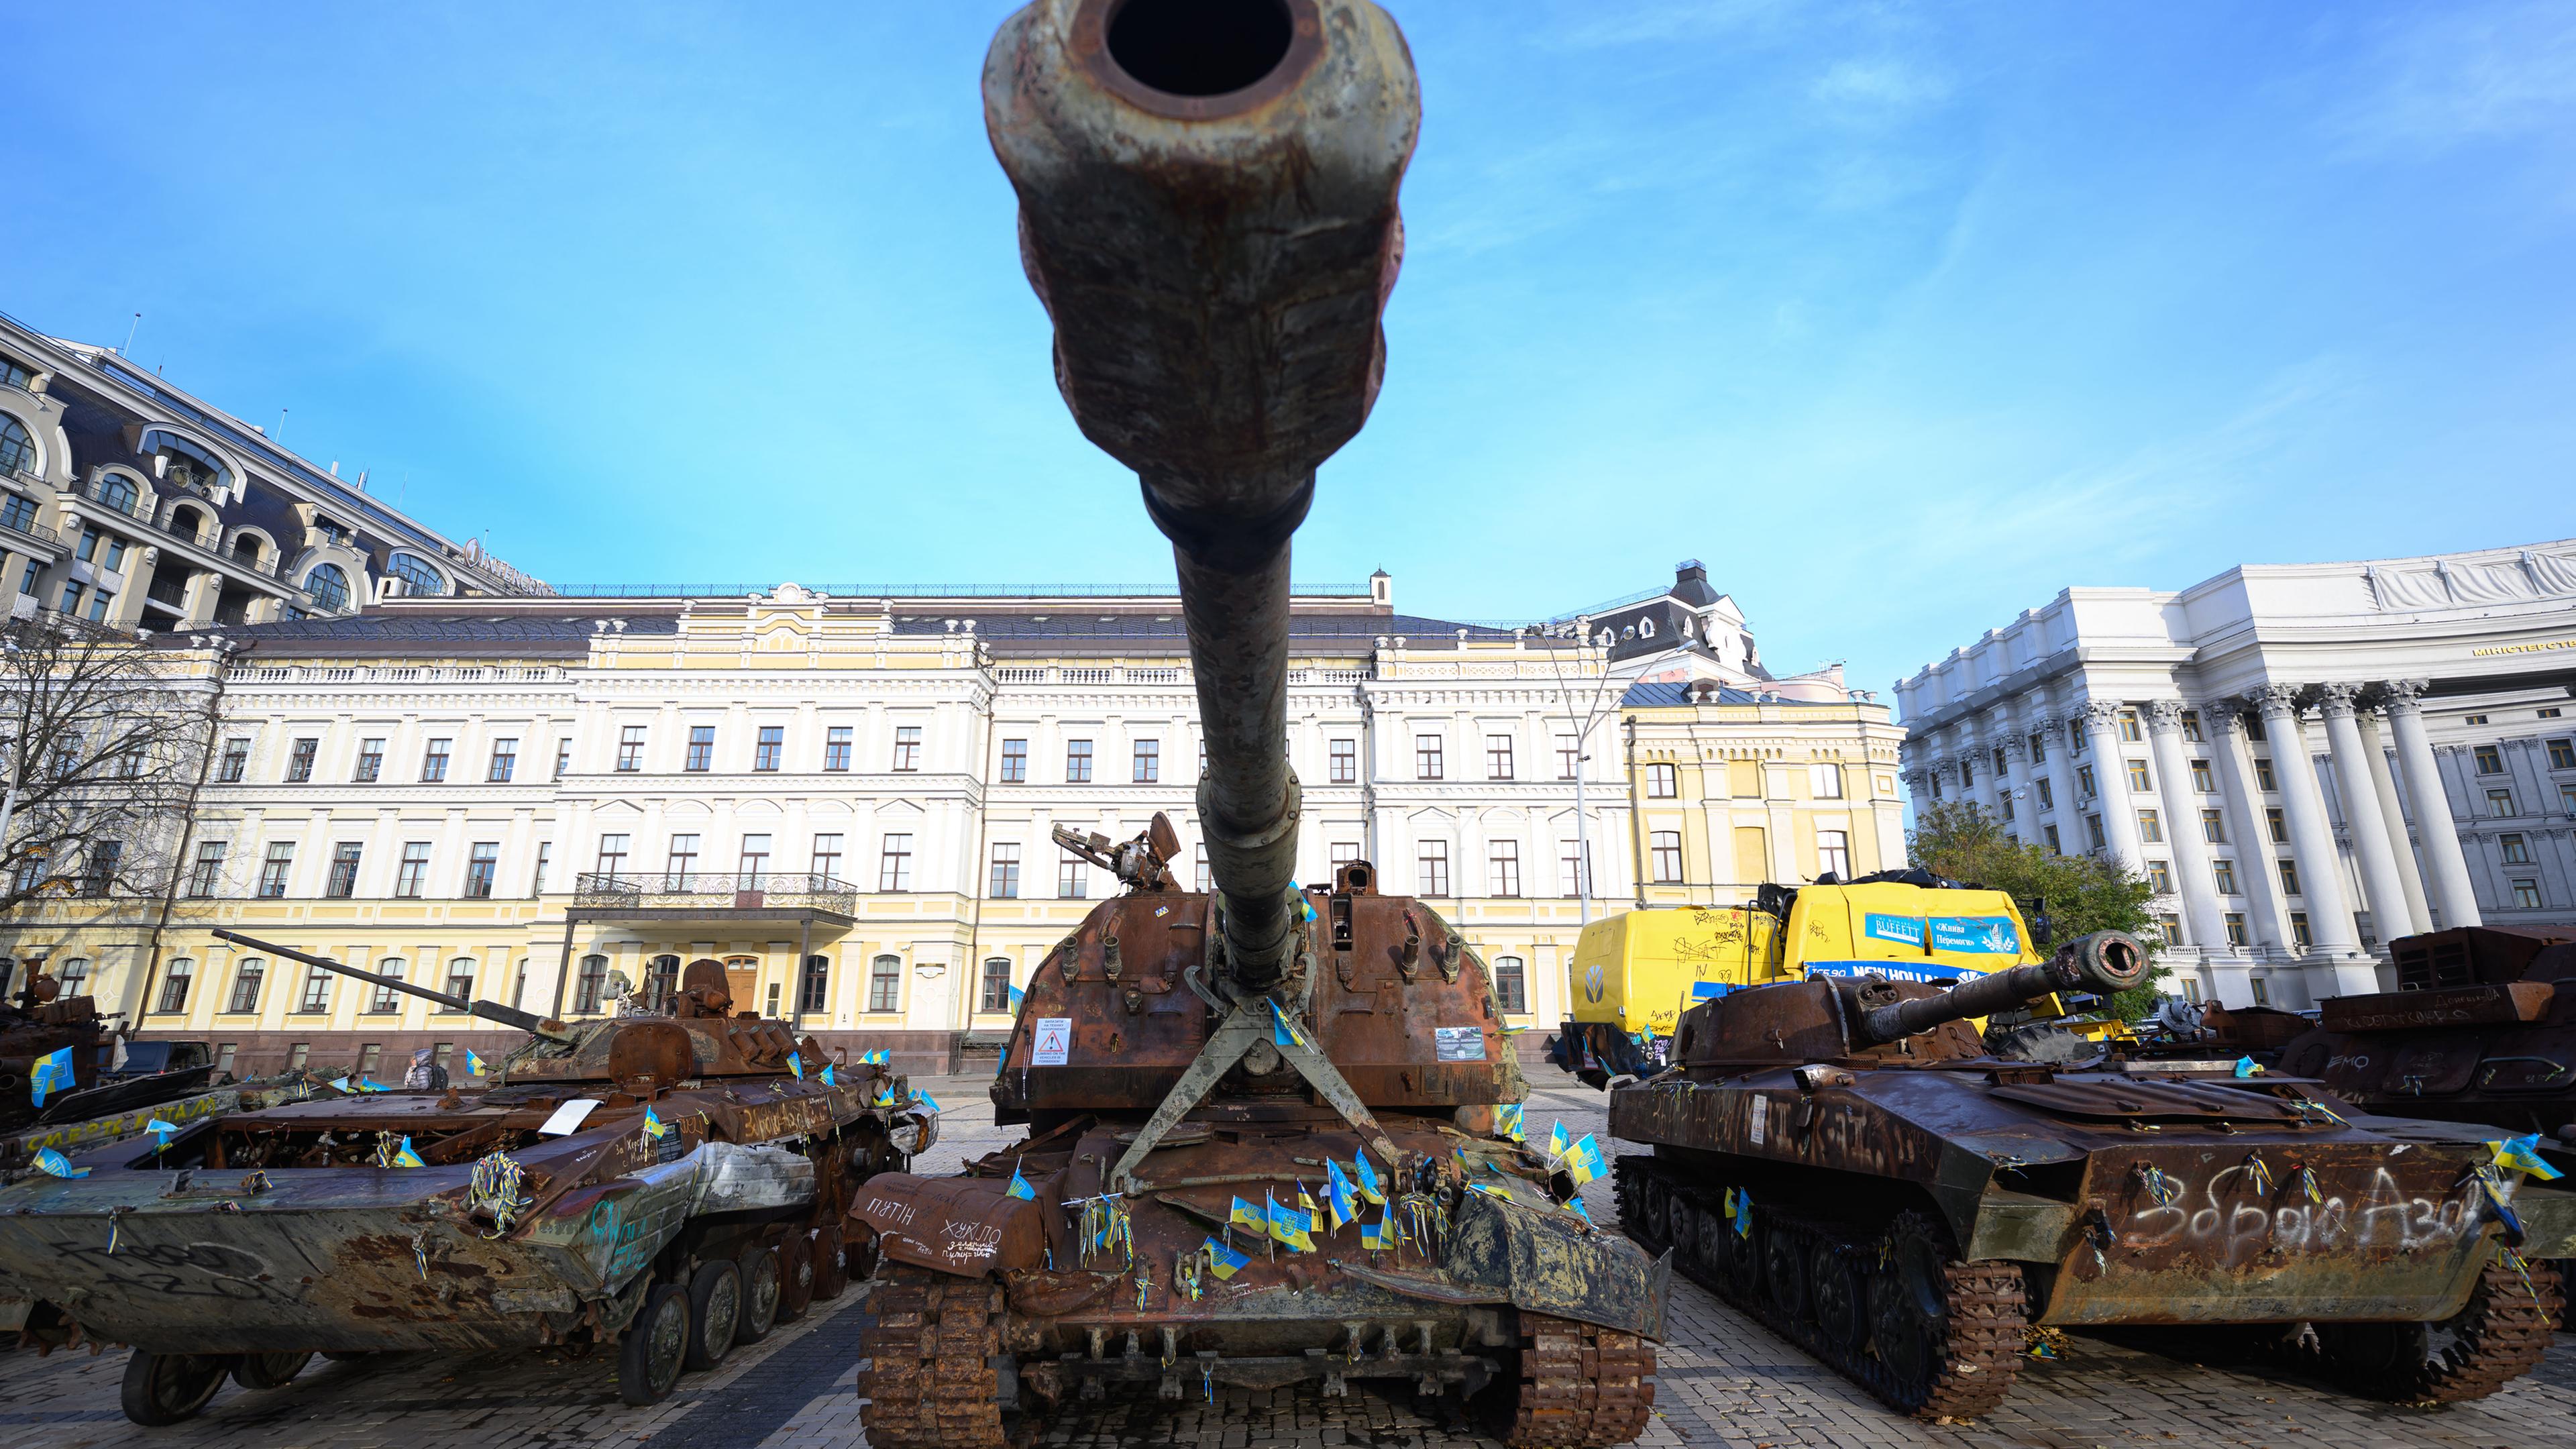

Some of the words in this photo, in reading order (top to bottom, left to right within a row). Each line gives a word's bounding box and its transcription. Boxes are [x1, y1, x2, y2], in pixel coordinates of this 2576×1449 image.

[1876, 920, 1919, 938] BUFFETT
[1936, 922, 1965, 933] «Жнива
[1937, 935, 1975, 947] Перемоги»
[28, 1118, 123, 1152] СМЕРТЬ
[867, 1197, 916, 1225] ПУТІН
[940, 1219, 1002, 1244] ХУЙЛО
